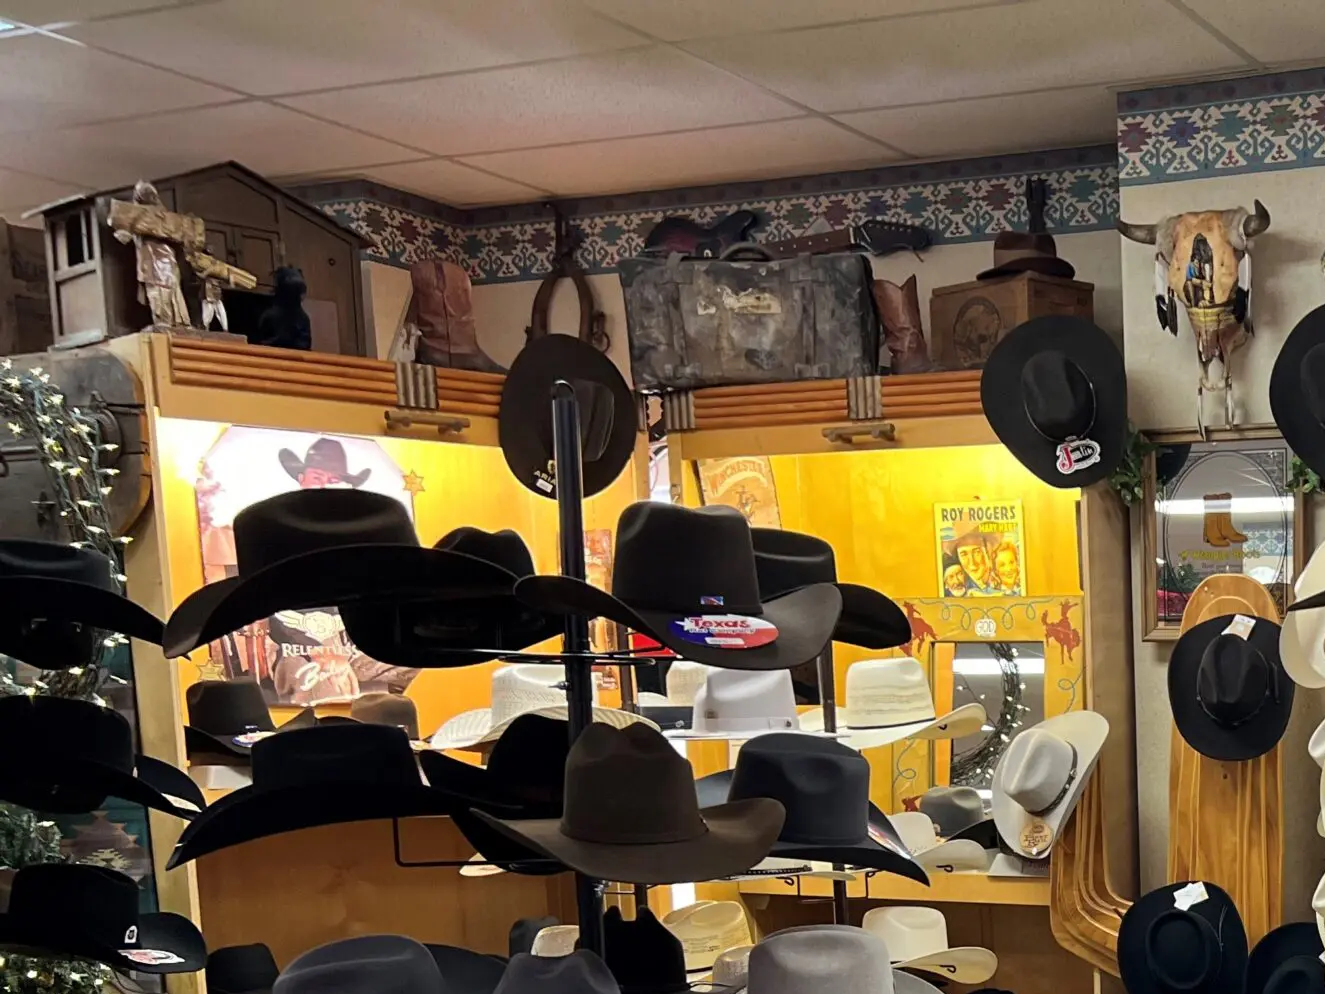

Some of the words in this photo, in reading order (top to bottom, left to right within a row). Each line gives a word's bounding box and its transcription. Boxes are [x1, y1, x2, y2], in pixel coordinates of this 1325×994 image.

[941, 507, 964, 521] ROY
[968, 505, 1016, 521] ROGERS
[689, 617, 751, 629] Texas
